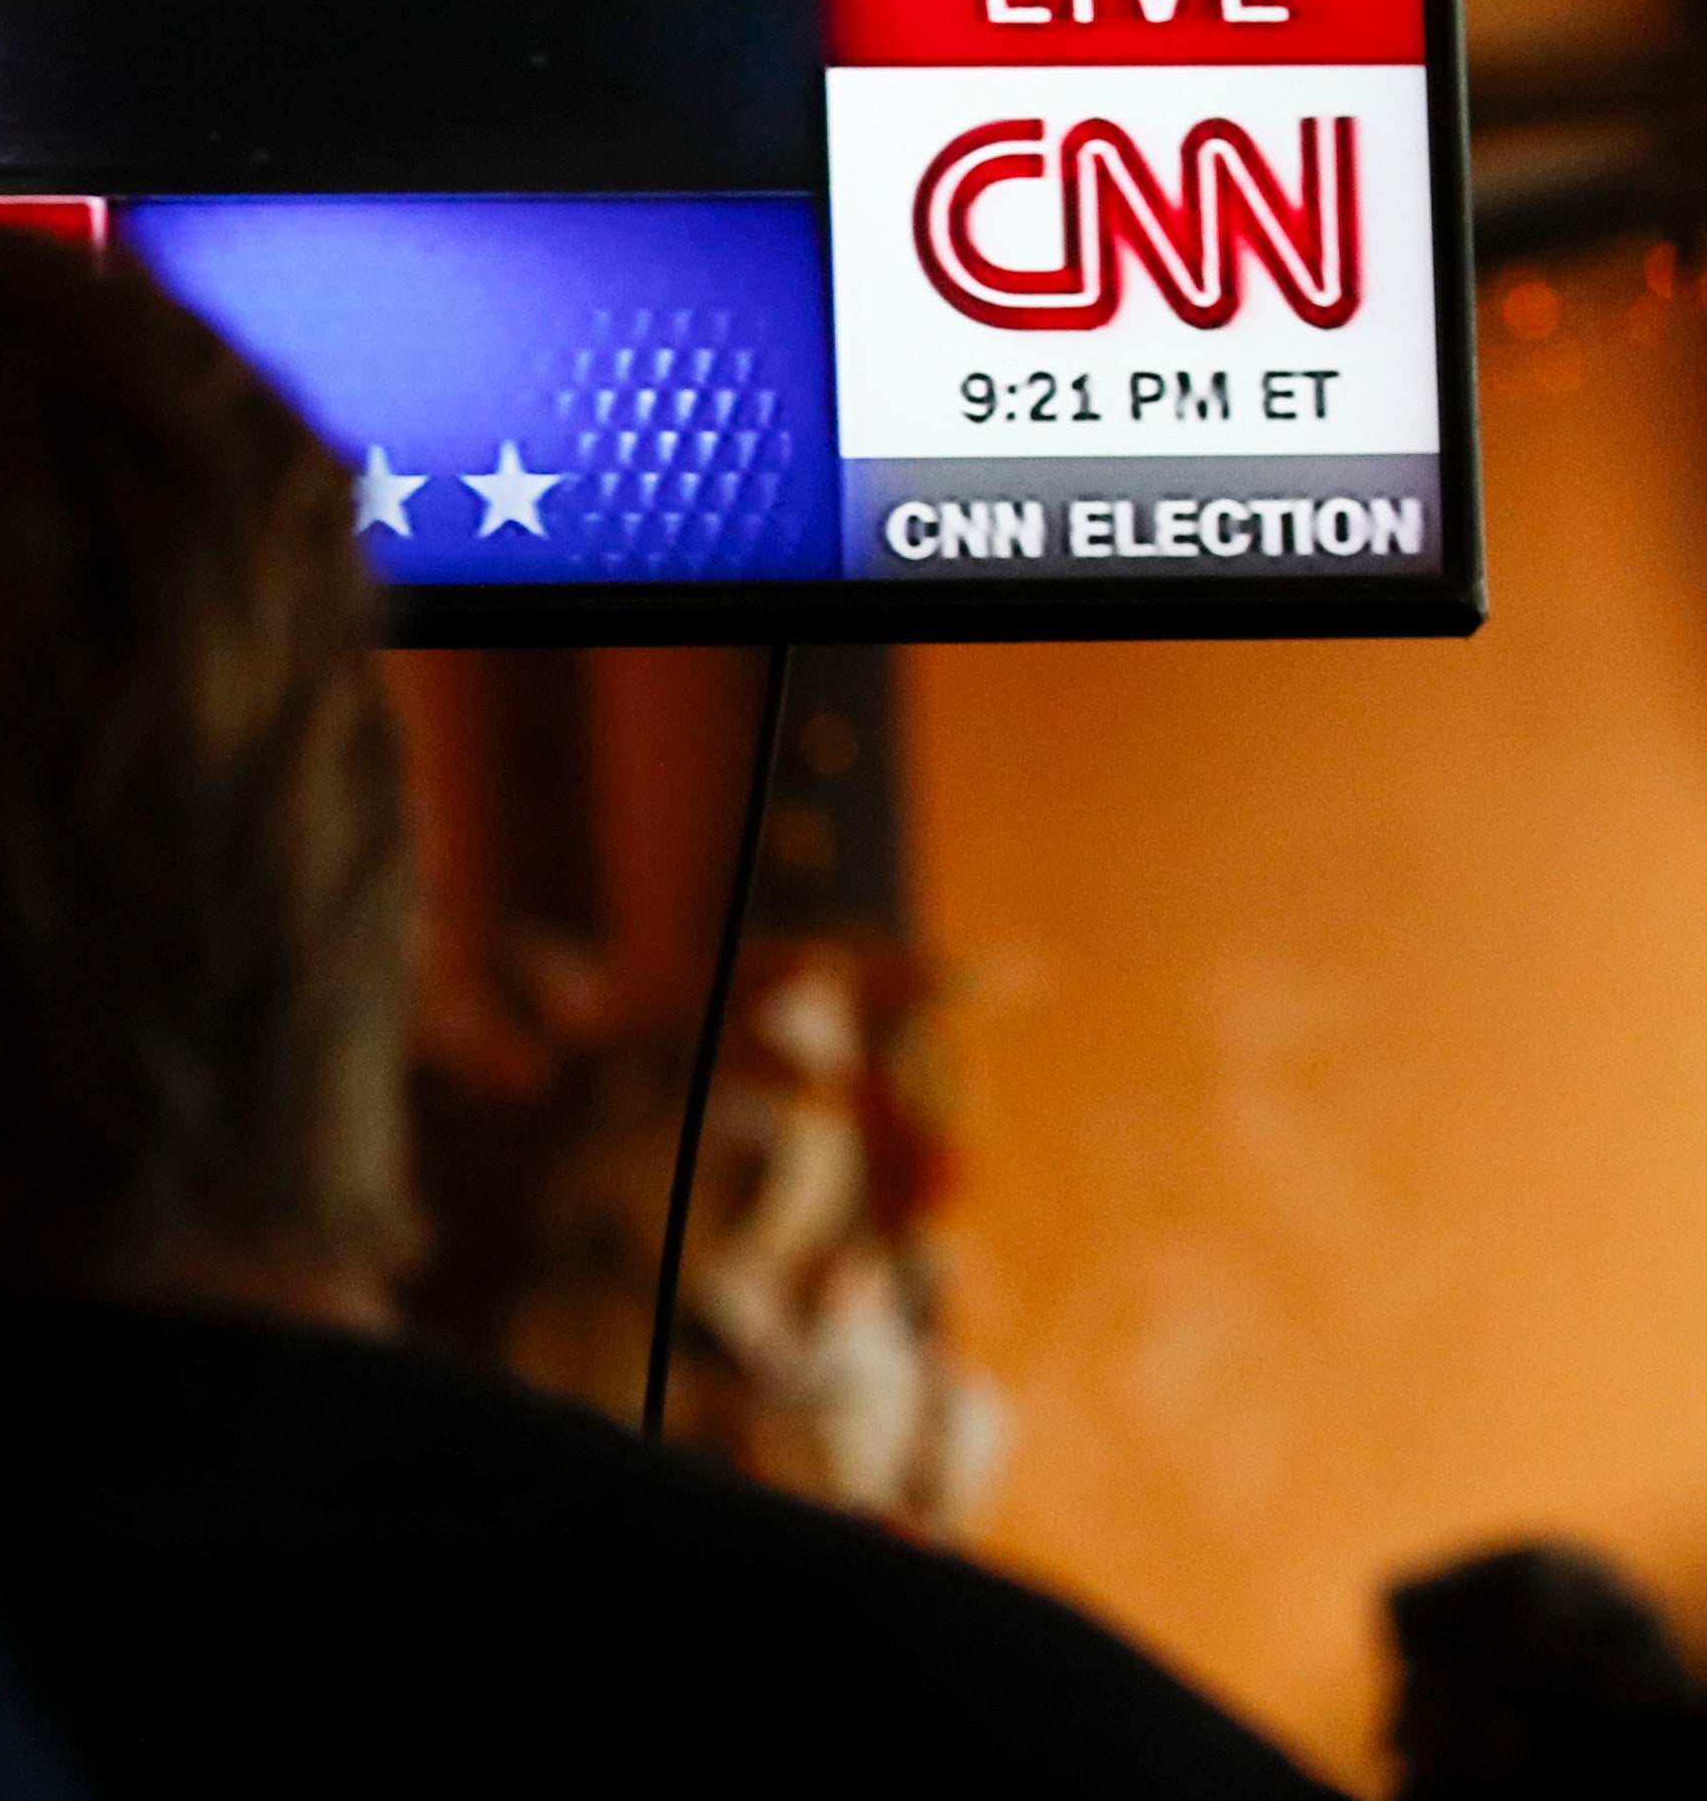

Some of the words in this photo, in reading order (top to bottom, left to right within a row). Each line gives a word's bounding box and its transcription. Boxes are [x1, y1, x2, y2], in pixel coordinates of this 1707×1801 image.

[912, 115, 1362, 332] CNN
[960, 370, 1102, 424] 9:21
[1129, 370, 1230, 421] PM
[1261, 370, 1341, 420] ET
[886, 500, 1046, 560] CNN
[1069, 496, 1422, 558] ELECTION
